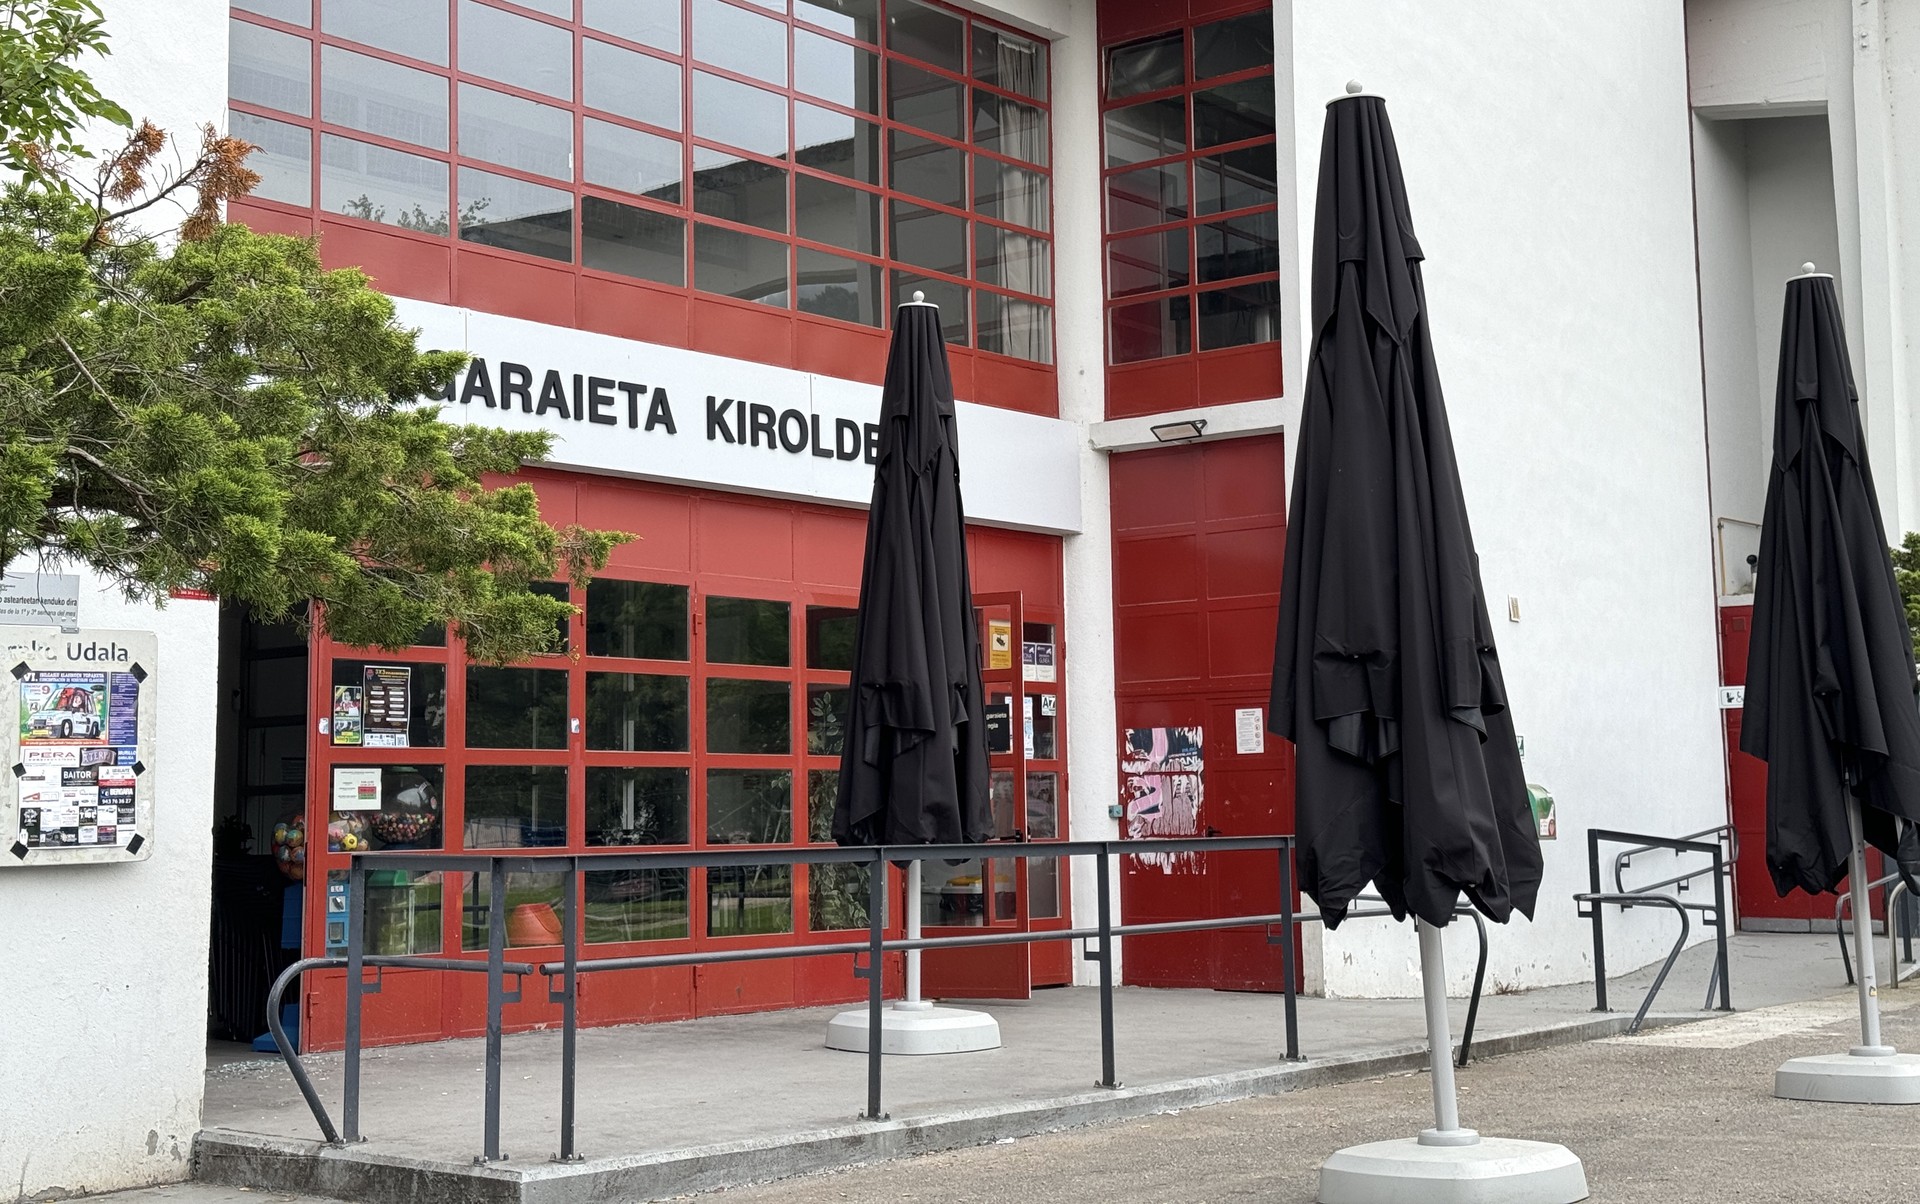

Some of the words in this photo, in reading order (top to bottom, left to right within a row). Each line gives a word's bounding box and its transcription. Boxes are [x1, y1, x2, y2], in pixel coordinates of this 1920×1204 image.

[67, 641, 128, 661] Udala
[41, 685, 51, 695] 9
[28, 751, 76, 759] PERA
[63, 770, 92, 779] BAITOR
